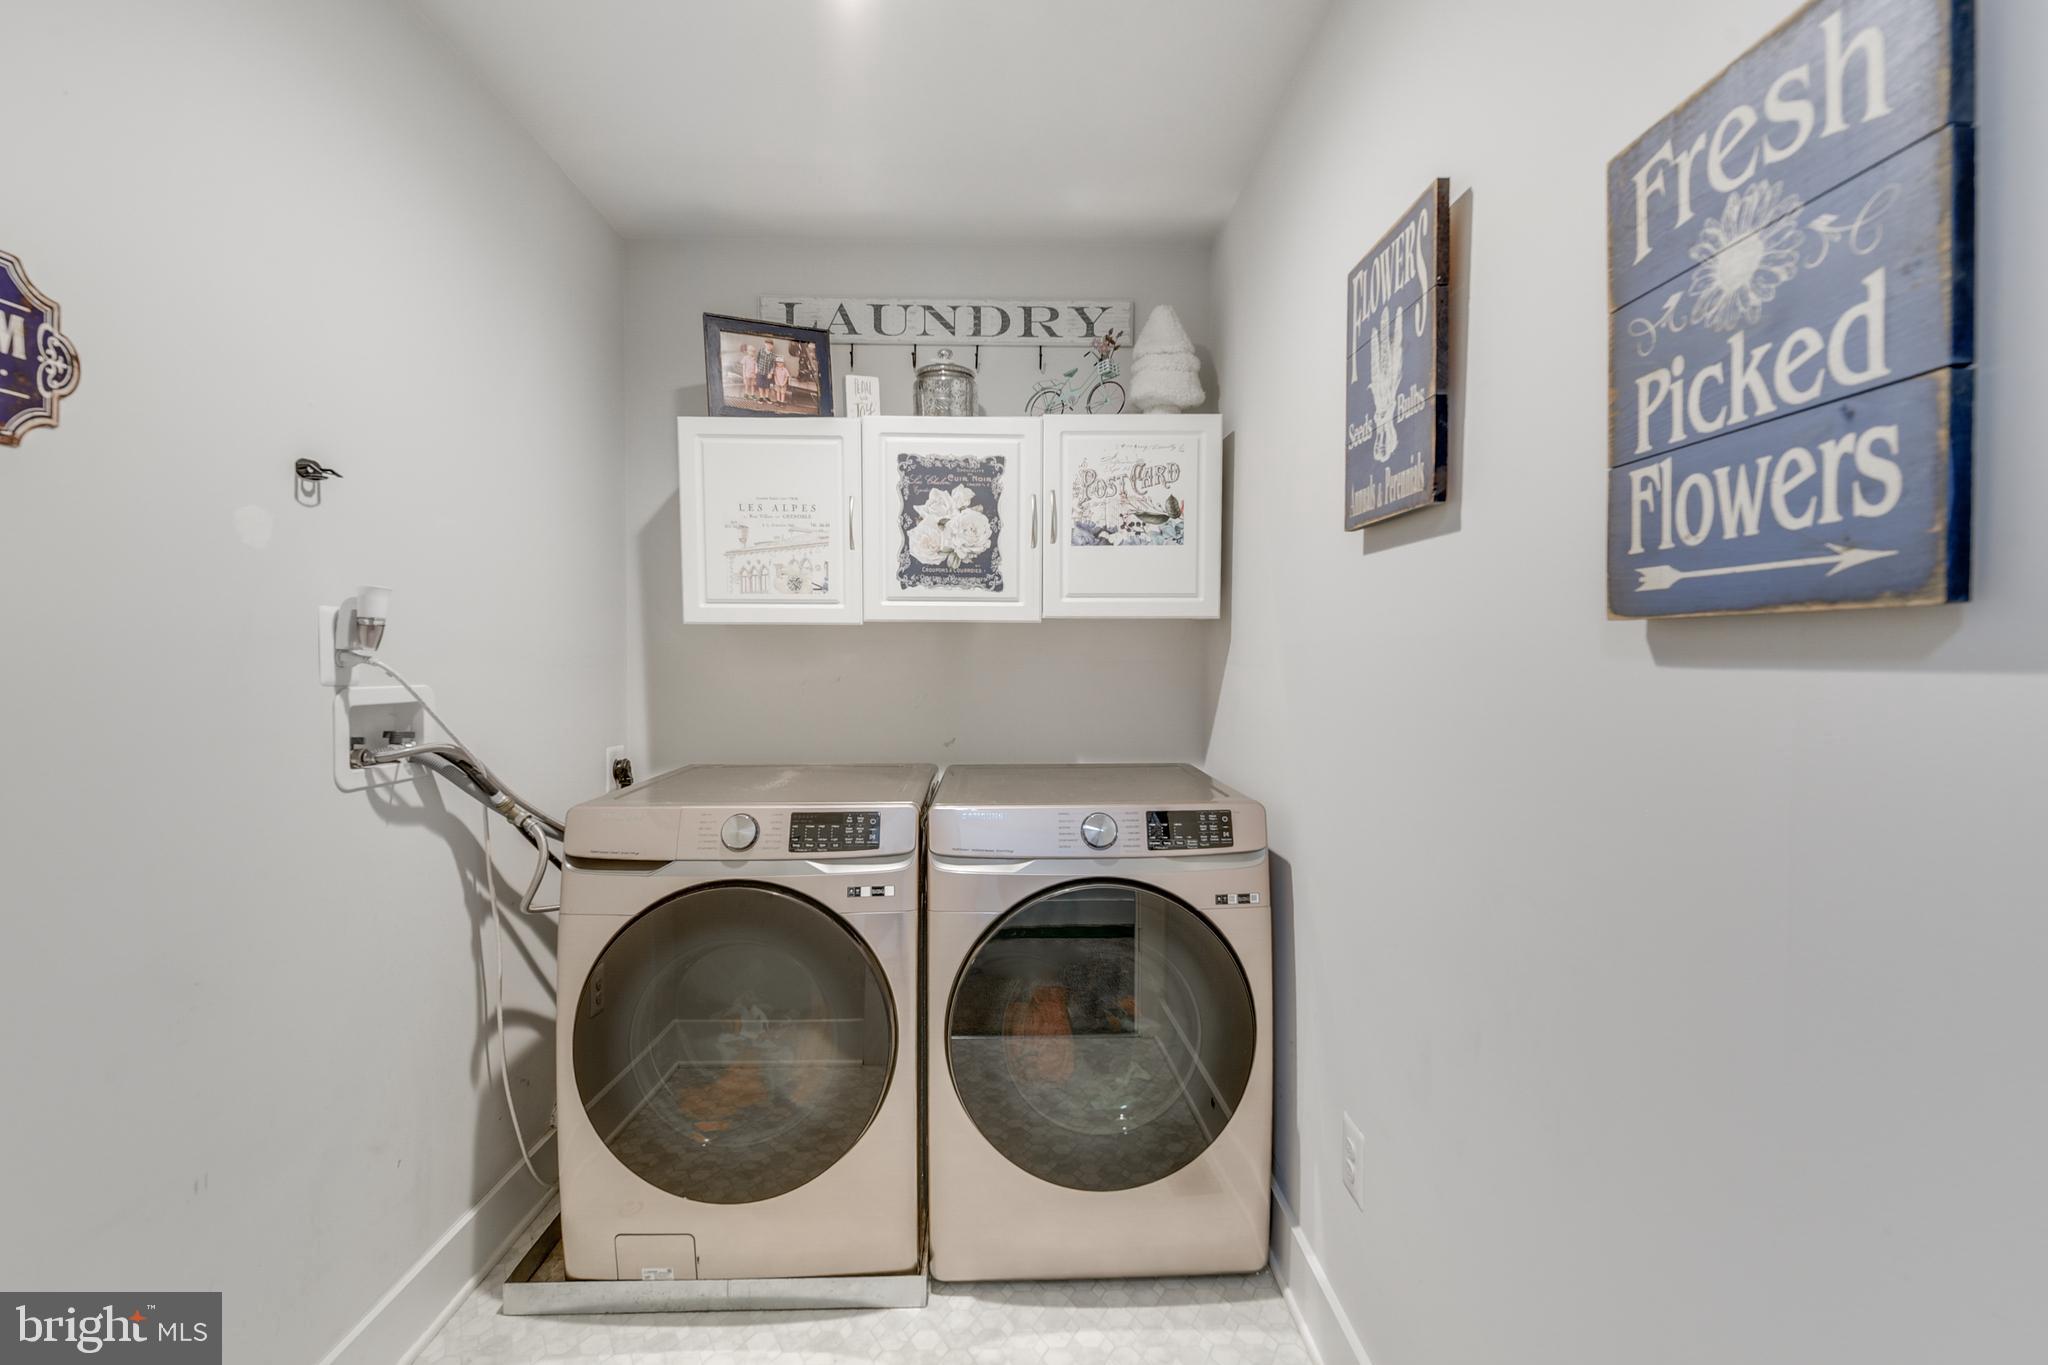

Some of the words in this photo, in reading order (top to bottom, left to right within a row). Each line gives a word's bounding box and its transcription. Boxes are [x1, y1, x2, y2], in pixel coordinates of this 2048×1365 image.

[1632, 10, 1893, 266] Fresh
[779, 302, 1114, 339] LAUNDRY
[1351, 208, 1428, 384] FLOWERS
[1348, 413, 1373, 450] Seeds
[1396, 384, 1426, 423] Bulbs
[1633, 267, 1891, 456] Picked
[738, 503, 764, 512] LES
[771, 503, 817, 512] ALPES
[1628, 425, 1902, 555] Flowers
